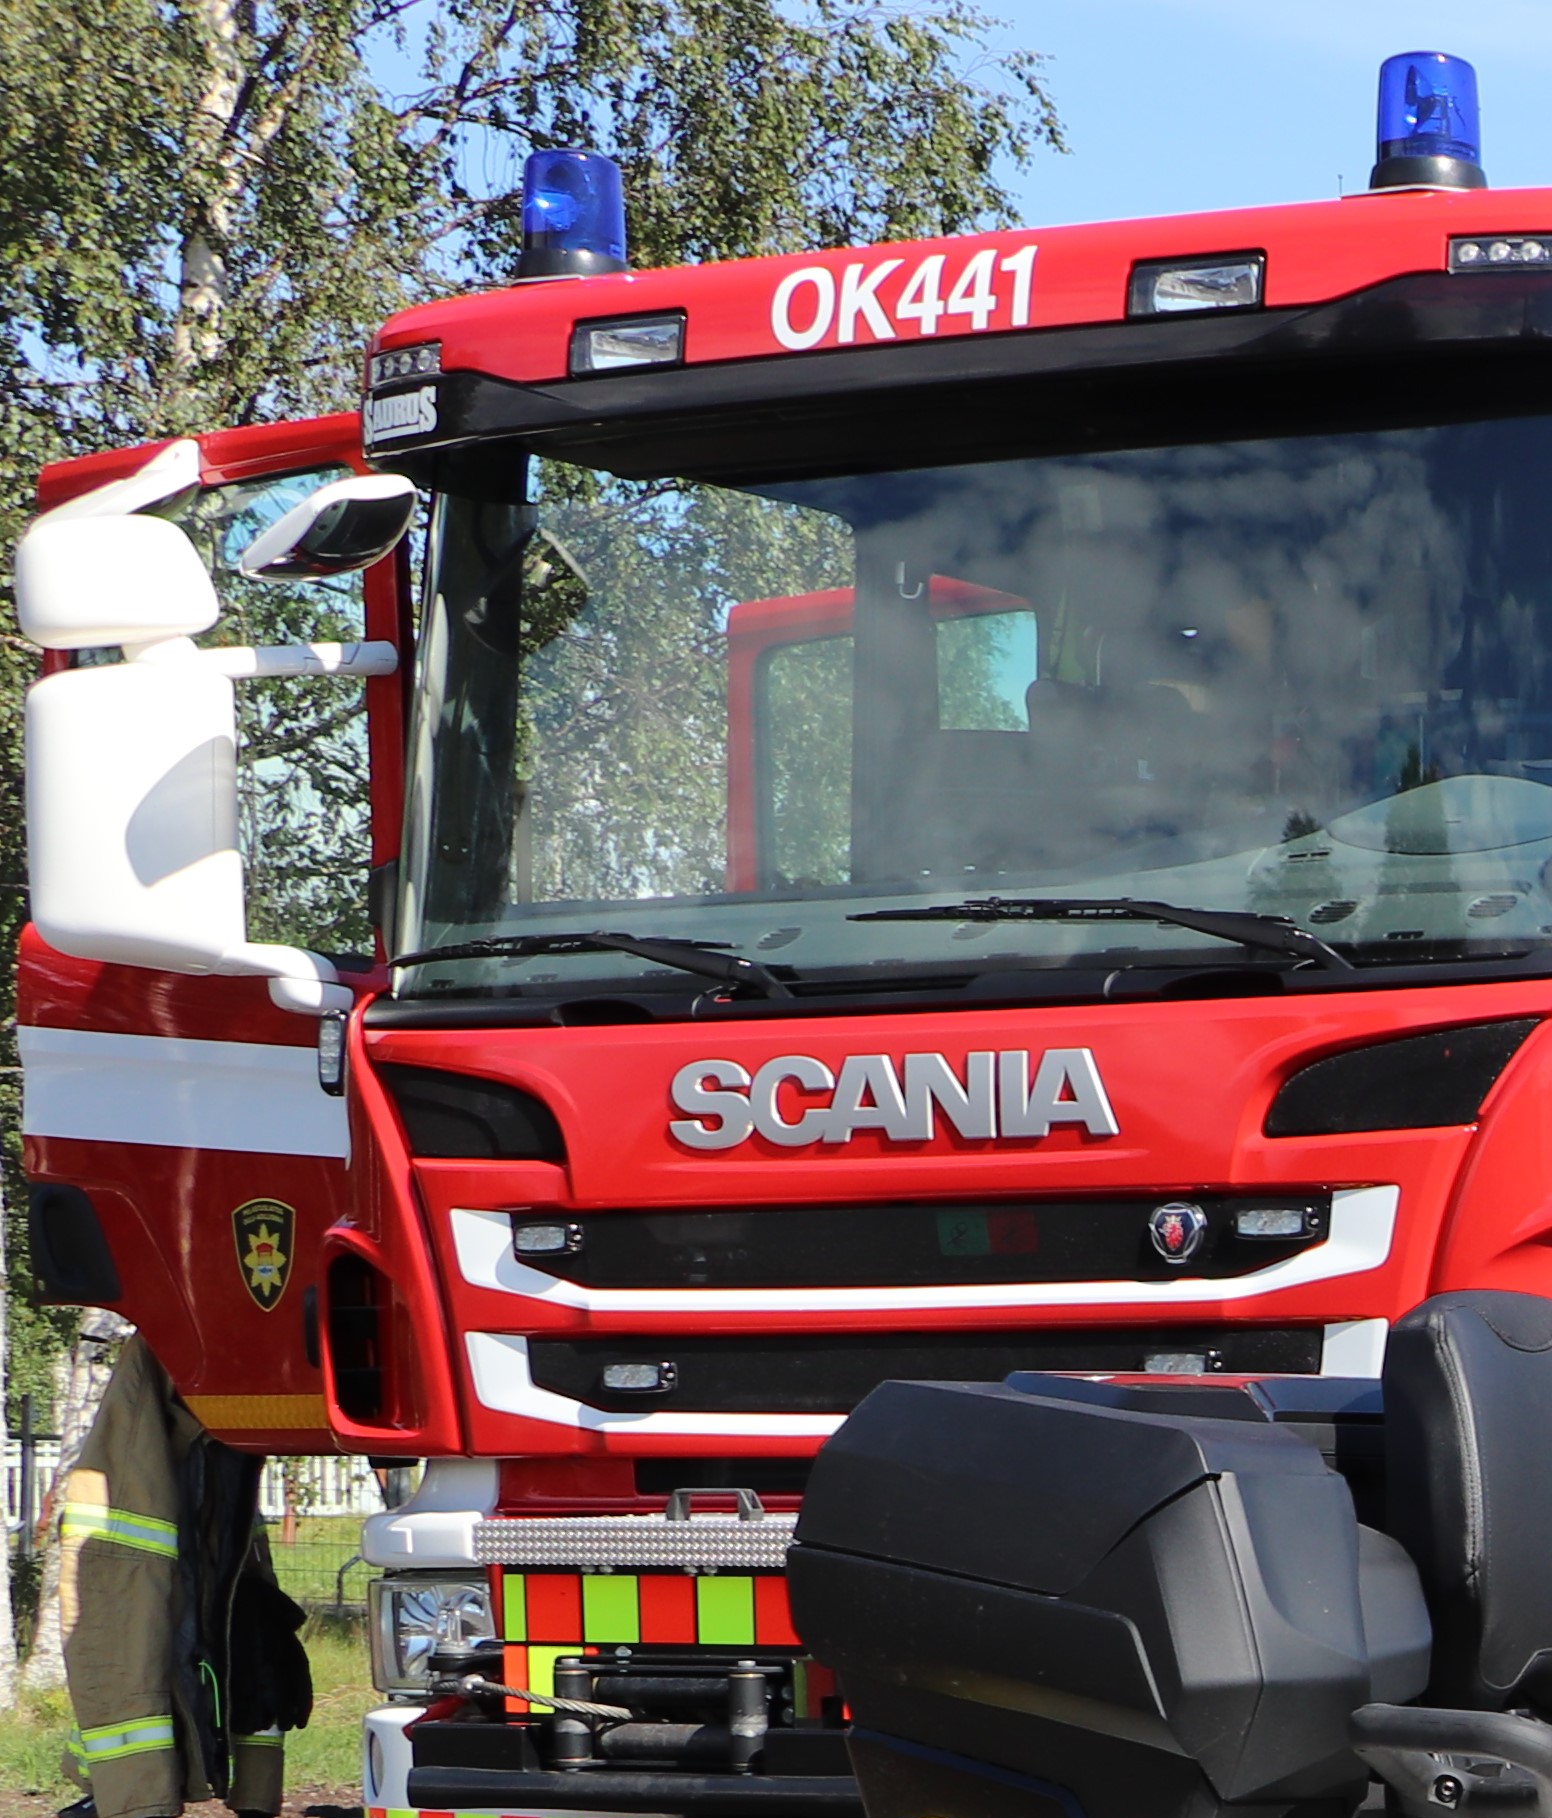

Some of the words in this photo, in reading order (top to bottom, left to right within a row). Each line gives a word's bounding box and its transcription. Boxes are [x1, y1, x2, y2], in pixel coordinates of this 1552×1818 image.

[771, 245, 1037, 351] OK441
[363, 386, 438, 445] SAURUS
[669, 1047, 1121, 1151] SCANIA
